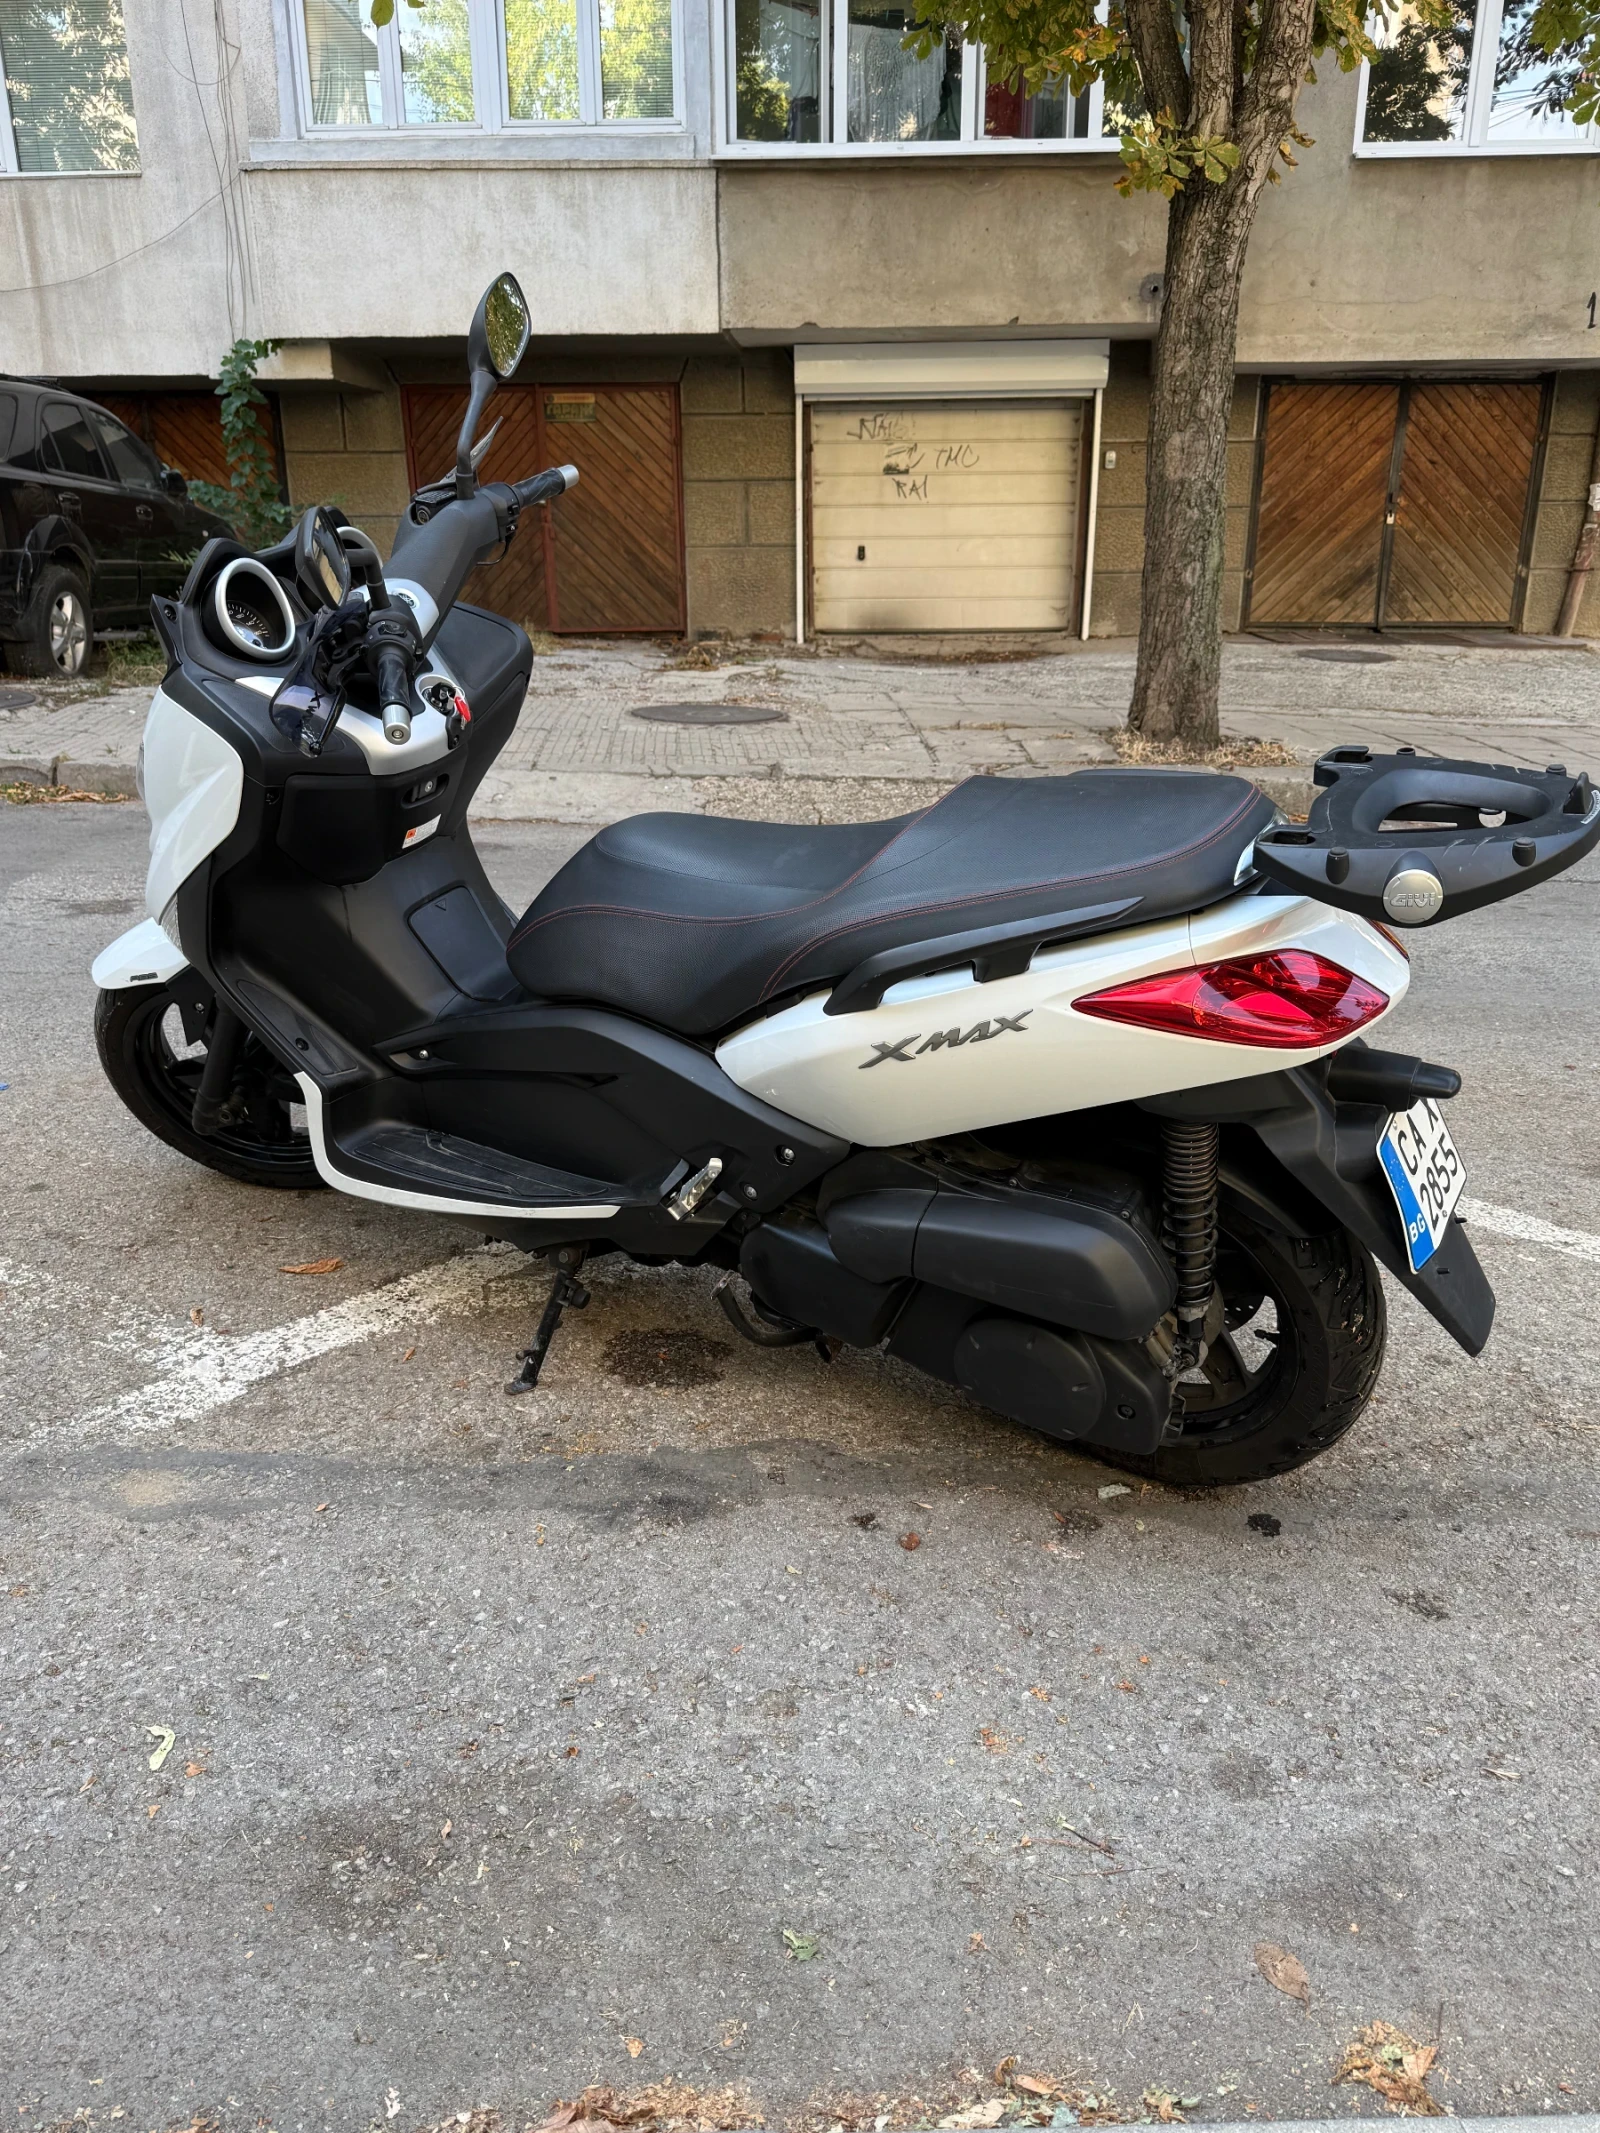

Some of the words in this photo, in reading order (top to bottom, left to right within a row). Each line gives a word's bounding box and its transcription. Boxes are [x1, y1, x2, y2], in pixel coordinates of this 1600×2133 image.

[1586, 291, 1597, 330] 1
[1397, 1113, 1427, 1176] CA
[1420, 1132, 1458, 1231] 2855
[1408, 1212, 1426, 1244] BG
